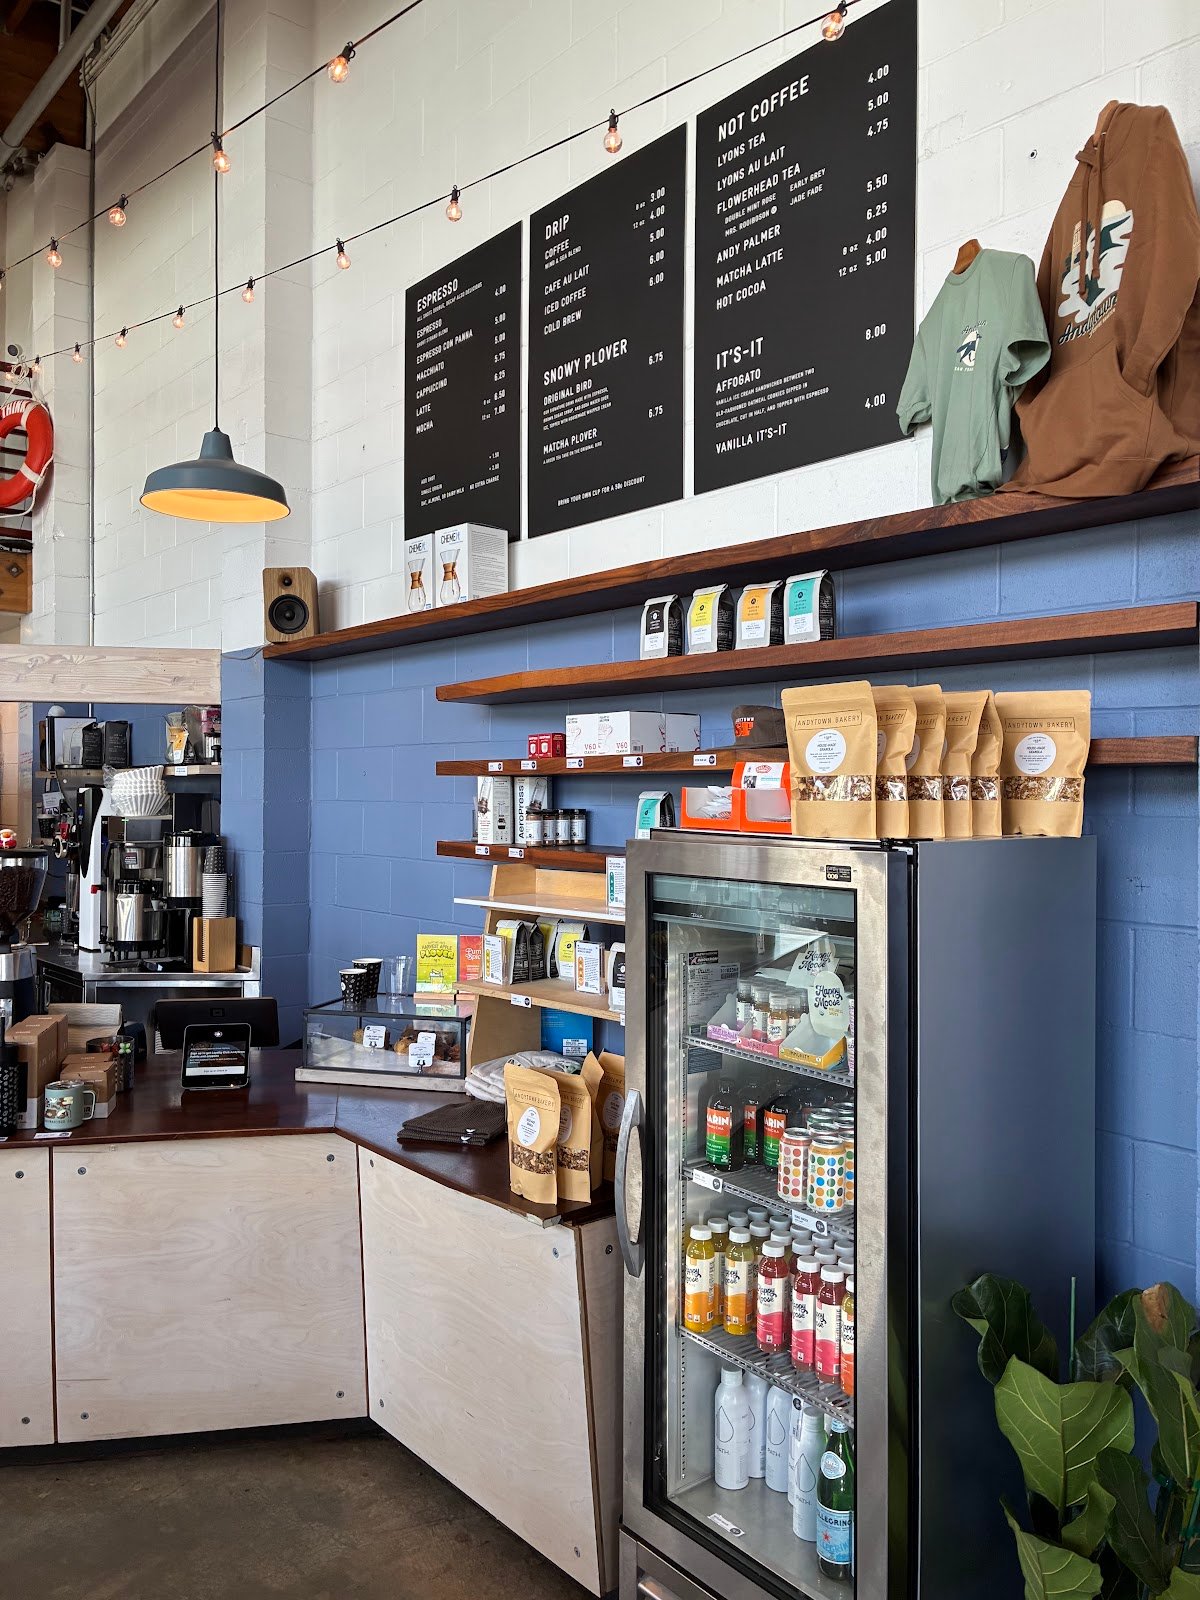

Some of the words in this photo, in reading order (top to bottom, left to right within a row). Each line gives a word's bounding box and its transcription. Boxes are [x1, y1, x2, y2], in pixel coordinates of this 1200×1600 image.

[867, 64, 889, 83] 4.00
[718, 112, 745, 142] NOT
[750, 74, 809, 123] COFFEE
[867, 91, 889, 111] 5.00
[867, 117, 889, 137] 4.75
[717, 143, 745, 167] LYONS
[748, 132, 766, 150] TEA
[717, 168, 745, 192] LYONS
[747, 159, 760, 175] AU
[764, 146, 786, 167] LAIT
[789, 177, 808, 192] EARLY
[809, 168, 826, 181] GREY
[650, 186, 666, 202] 3.00
[717, 174, 779, 215] FLOWERHEAD
[781, 163, 801, 180] TEA
[789, 192, 806, 206] JADE
[807, 183, 823, 197] FADE
[866, 173, 888, 193] 5.50
[632, 221, 639, 230] 12
[649, 204, 665, 220] 4.00
[725, 208, 746, 225] DOUBLE
[746, 201, 760, 214] MINT
[761, 192, 777, 206] ROSE
[866, 201, 888, 220] 6.25
[545, 214, 570, 241] DRIP
[649, 227, 665, 243] 5.00
[725, 226, 738, 237] MRS.
[544, 238, 570, 260] COFFEE
[716, 243, 740, 264] ANDY
[743, 224, 781, 251] PALMER
[849, 243, 859, 253] oz
[866, 226, 887, 245] 4.00
[649, 249, 665, 265] 6.00
[716, 263, 753, 288] MATCHA
[755, 248, 784, 271] LATTE
[838, 266, 847, 278] 12
[848, 263, 858, 273] oz
[866, 247, 887, 266] 5.00
[544, 278, 561, 296] CAFE
[562, 273, 573, 287] AU
[574, 263, 590, 280] LAIT
[649, 271, 664, 287] 6.00
[417, 278, 458, 313] ESPRESSO
[544, 300, 560, 316] ICED
[560, 286, 587, 308] COFFEE
[716, 293, 733, 310] HOT
[736, 279, 767, 302] COCOA
[416, 318, 442, 339] ESPRESSO
[543, 319, 561, 336] COLD
[562, 309, 583, 327] BREW
[865, 323, 886, 341] 8.00
[416, 344, 442, 365] ESPRESSO
[442, 338, 454, 351] CON
[454, 328, 474, 345] PANNA
[648, 351, 664, 365] 6.75
[716, 336, 764, 371] IT'S-IT
[416, 361, 445, 382] MACCHIATO
[543, 357, 581, 386] SNOWY
[584, 338, 628, 370] PLOVER
[416, 377, 448, 400] CAPPUCCINO
[715, 368, 761, 394] AFFOGATO
[755, 378, 783, 393] SANDWICHED
[783, 371, 804, 384] BETWEEN
[804, 367, 815, 376] TWO
[543, 386, 574, 406] ORIGINAL
[575, 378, 593, 394] BIRD
[740, 413, 748, 421] CUT
[776, 398, 793, 409] TOPPED
[793, 394, 805, 403] WITH
[805, 386, 830, 400] ESPRESSO
[864, 393, 886, 409] 4.00
[416, 402, 431, 417] LATTE
[648, 404, 664, 419] 6.75
[416, 419, 434, 435] MOCHA
[715, 433, 753, 454] VANILLA
[756, 422, 787, 443] IT'S-IT
[543, 437, 569, 455] MATCHA
[571, 427, 598, 446] PLOVER
[557, 497, 570, 507] BRING
[570, 494, 581, 503] YOUR
[581, 490, 592, 499] OWN
[592, 488, 601, 497] CUP
[601, 485, 610, 494] FOR
[623, 475, 645, 488] DISCOUNT
[440, 531, 461, 545] CHEMEX
[797, 717, 832, 726] ANDYTOWN
[835, 714, 860, 724] BAKERY
[1007, 721, 1043, 729] ANDYTOWN
[584, 743, 597, 751] V60
[616, 741, 628, 749] V60
[804, 950, 832, 963] Happy
[814, 996, 841, 1010] Moose
[815, 984, 843, 1001] Happy
